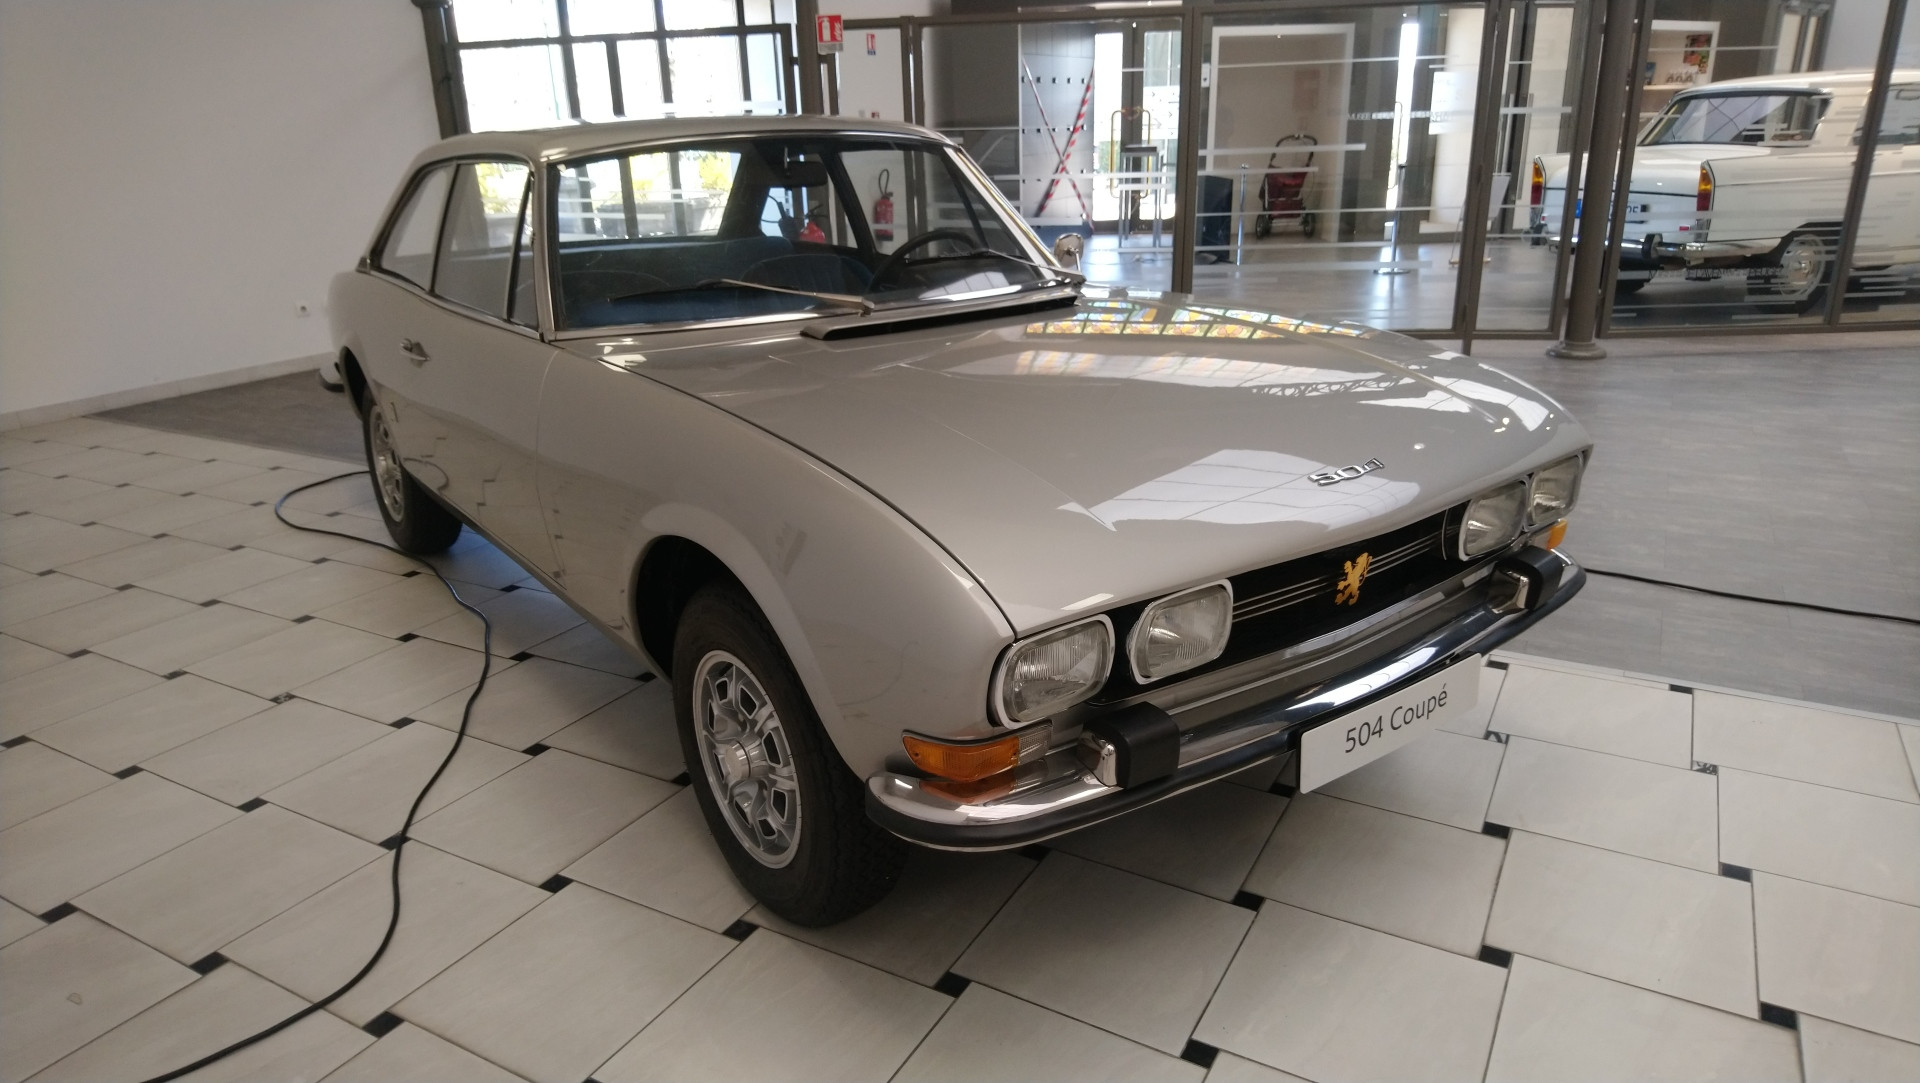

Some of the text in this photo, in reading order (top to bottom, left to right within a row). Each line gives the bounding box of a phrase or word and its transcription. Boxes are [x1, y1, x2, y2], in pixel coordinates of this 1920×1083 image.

[1307, 457, 1385, 487] 504
[1345, 683, 1448, 754] 504 Coupé
